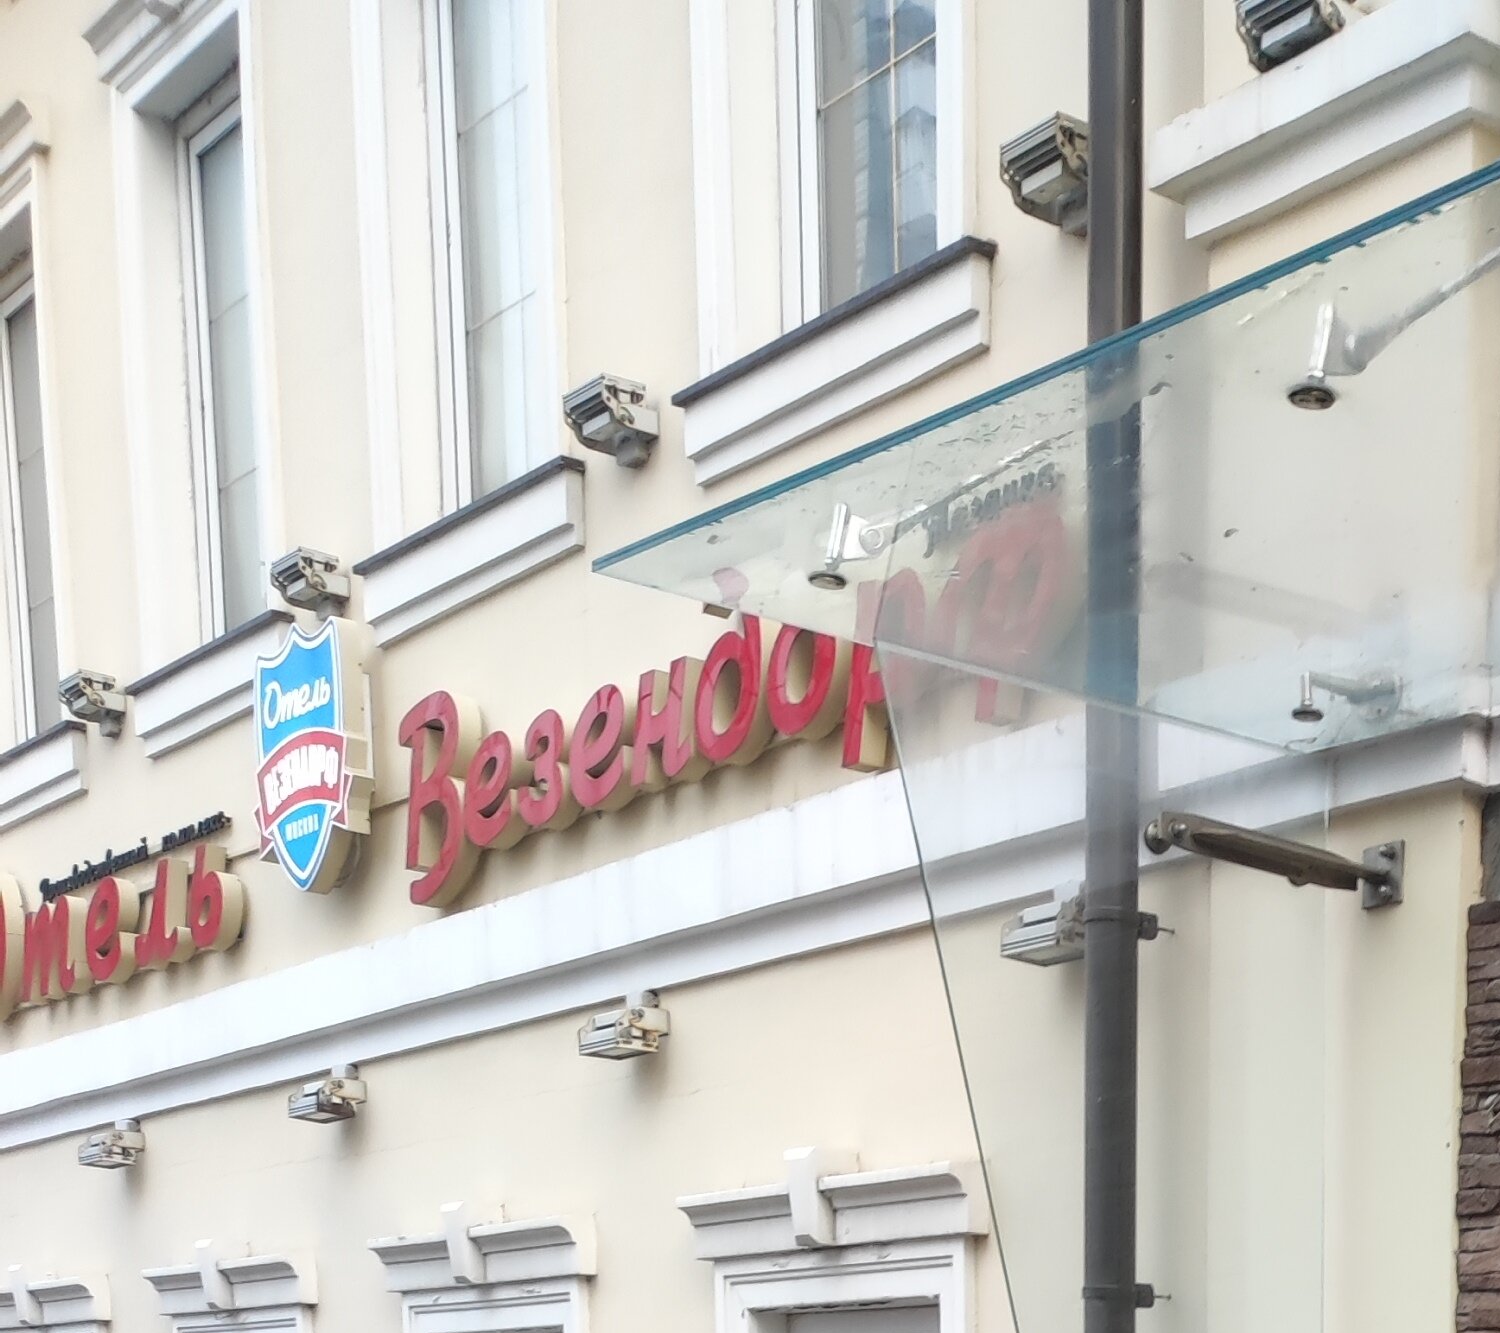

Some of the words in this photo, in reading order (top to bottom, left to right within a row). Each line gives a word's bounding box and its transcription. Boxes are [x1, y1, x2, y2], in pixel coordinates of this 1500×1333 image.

[0, 845, 224, 1004] тель
[400, 496, 1068, 908] Везендорф
[264, 676, 331, 729] Отель
